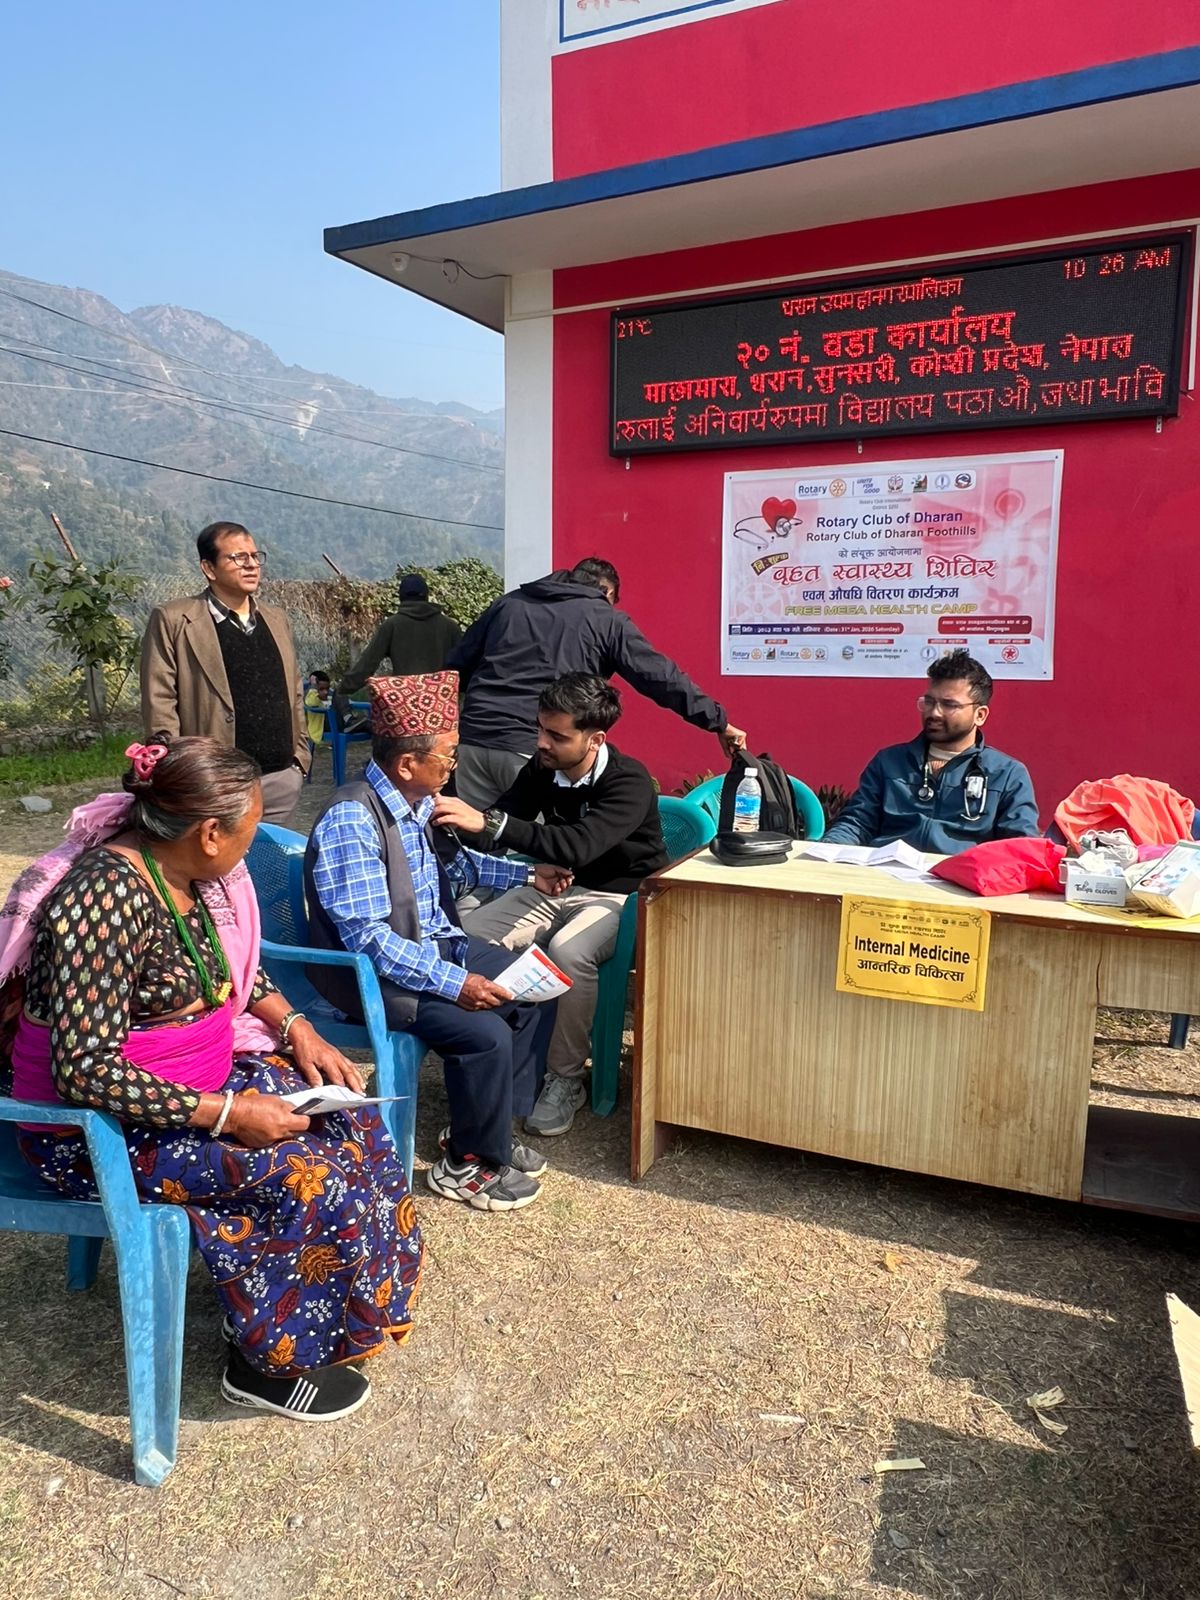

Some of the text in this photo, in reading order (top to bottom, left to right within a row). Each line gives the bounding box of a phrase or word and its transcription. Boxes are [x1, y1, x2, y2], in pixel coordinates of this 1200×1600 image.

[1133, 246, 1171, 272] AM
[782, 297, 818, 317] धरान
[736, 341, 771, 370] २०
[822, 327, 879, 358] वडा
[886, 305, 1017, 351] कार्यालय
[1059, 332, 1135, 364] नेपाल
[837, 392, 935, 427] विद्यालय
[798, 484, 828, 496] Rotary
[816, 511, 963, 529] Rotary Club of Dharan
[806, 525, 977, 543] Rotary Club of Dharan Foothills
[832, 561, 912, 581] स्वास्थ्य
[926, 554, 998, 579] शिविर
[828, 585, 863, 600] औषधि
[866, 587, 905, 600] वितरण
[908, 584, 959, 600] कार्यक्रम
[785, 603, 979, 617] FREE MEGA HEALTH CAMP
[854, 935, 970, 964] Internal Medicine
[857, 958, 965, 983] आन्तरिक चिकित्सा
